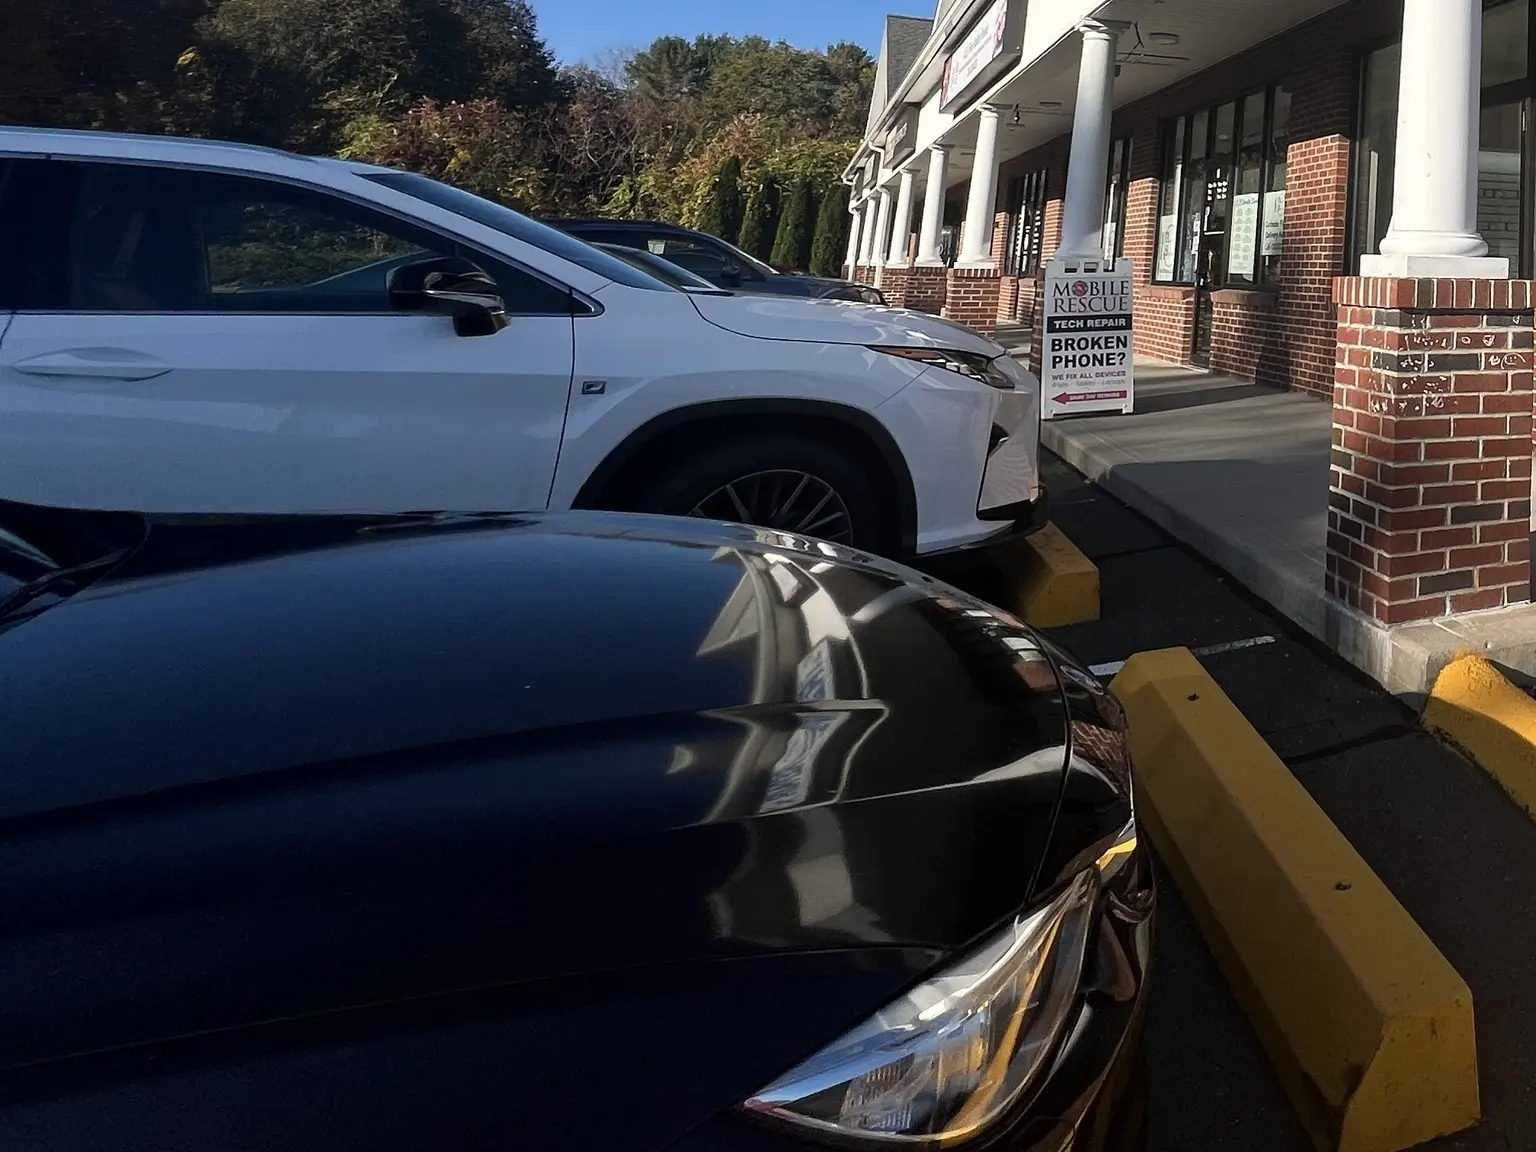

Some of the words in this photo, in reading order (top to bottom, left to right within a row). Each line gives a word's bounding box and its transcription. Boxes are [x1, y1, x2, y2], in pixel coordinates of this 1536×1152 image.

[1053, 280, 1129, 297] MOBILE
[1054, 296, 1129, 314] RESCUE
[1054, 319, 1084, 329] TECH
[1087, 318, 1126, 328] REPAIR
[1051, 335, 1128, 352] BROKEN
[1052, 352, 1127, 369] PHONE?
[1095, 370, 1126, 378] DEVICES
